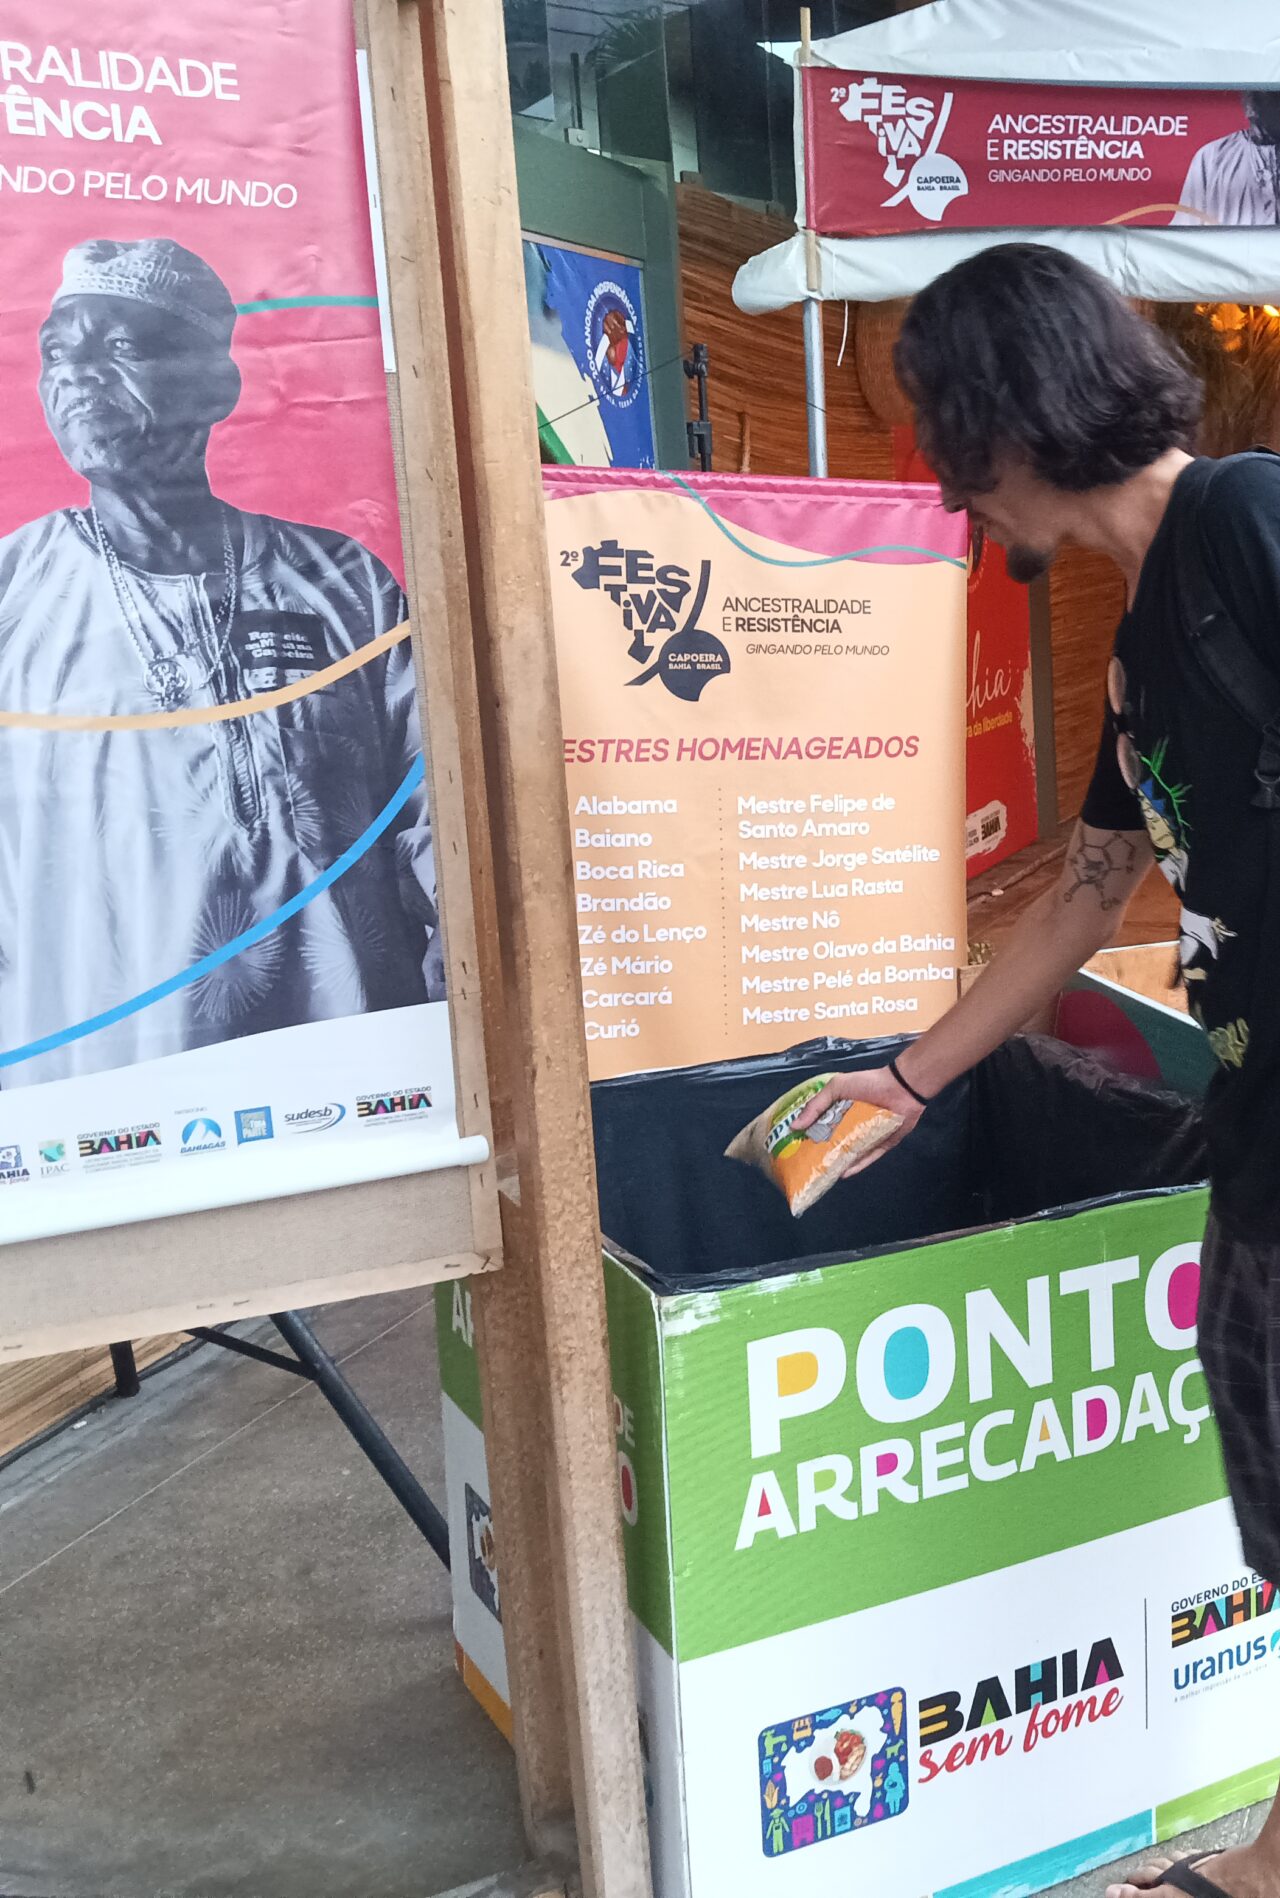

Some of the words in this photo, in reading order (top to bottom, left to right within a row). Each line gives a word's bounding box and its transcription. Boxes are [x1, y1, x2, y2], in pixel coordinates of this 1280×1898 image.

[0, 85, 162, 145] ÊNCIA
[987, 113, 1188, 137] ANCESTRALIDADE
[987, 140, 999, 161] E
[1003, 135, 1144, 161] RESISTÊNCIA
[916, 176, 961, 185] CAPOEIRA
[988, 167, 1061, 183] GINGANDO
[1063, 167, 1097, 182] PELO
[1099, 167, 1152, 182] MUNDO
[83, 170, 168, 203] PELO
[175, 177, 298, 209] MUNDO
[560, 550, 579, 567] 2º
[722, 596, 872, 615] ANCESTRALIDADE
[722, 617, 732, 632] E
[735, 615, 842, 634] RESISTÊNCIA
[668, 652, 723, 663] CAPOEIRA
[746, 643, 812, 656] GINGANDO
[814, 644, 843, 656] PELO
[845, 644, 890, 657] MUNDO
[676, 735, 920, 762] HOMENAGEADOS
[574, 796, 677, 816] Alabama
[737, 796, 807, 816] Mestre
[809, 795, 868, 817] Felipe
[871, 794, 895, 812] de
[575, 829, 653, 849] Baiano
[738, 820, 798, 840] Santo
[801, 818, 870, 838] Amaro
[738, 851, 807, 872] Mestre
[811, 849, 868, 872] Jorge
[870, 844, 941, 865] Satélite
[576, 861, 634, 881] Boca
[638, 859, 685, 879] Rica
[739, 882, 808, 902] Mestre
[811, 880, 848, 900] Lua
[850, 878, 904, 896] Rasta
[576, 892, 672, 913] Brandão
[740, 913, 808, 933] Mestre
[812, 910, 841, 930] Nô
[578, 925, 606, 946] Zé
[611, 924, 639, 944] do
[643, 923, 707, 946] Lenço
[741, 944, 809, 964] Mestre
[812, 941, 869, 960] Olavo
[871, 938, 897, 956] da
[899, 933, 955, 953] Bahia
[579, 957, 607, 977] Zé
[611, 954, 673, 976] Mário
[741, 975, 809, 995] Mestre
[813, 969, 853, 990] Pelé
[857, 969, 882, 987] da
[884, 965, 954, 984] Bomba
[582, 985, 673, 1009] Carcará
[742, 1005, 810, 1026] Mestre
[813, 1000, 869, 1021] Santa
[871, 995, 918, 1014] Rosa
[584, 1018, 640, 1041] Curió
[355, 1092, 391, 1102] GOVERNO
[393, 1089, 404, 1097] DO
[404, 1085, 431, 1094] ESTADO
[357, 1093, 432, 1117] BAHIA
[284, 1106, 332, 1122] sudesb
[77, 1129, 116, 1140] GOVERNO
[118, 1127, 129, 1135] DO
[131, 1122, 160, 1132] ESTADO
[78, 1130, 162, 1157] BAHIA
[40, 1163, 71, 1176] IPAC
[746, 1241, 1202, 1459] PONTO
[734, 1357, 1215, 1551] ARRECADAÇ
[1171, 1583, 1229, 1613] GOVERNO
[1232, 1576, 1248, 1591] DO
[1173, 1635, 1267, 1691] uranus
[918, 1637, 1124, 1747] BAHIA
[917, 1726, 1012, 1784] sem
[1022, 1686, 1124, 1754] fome
